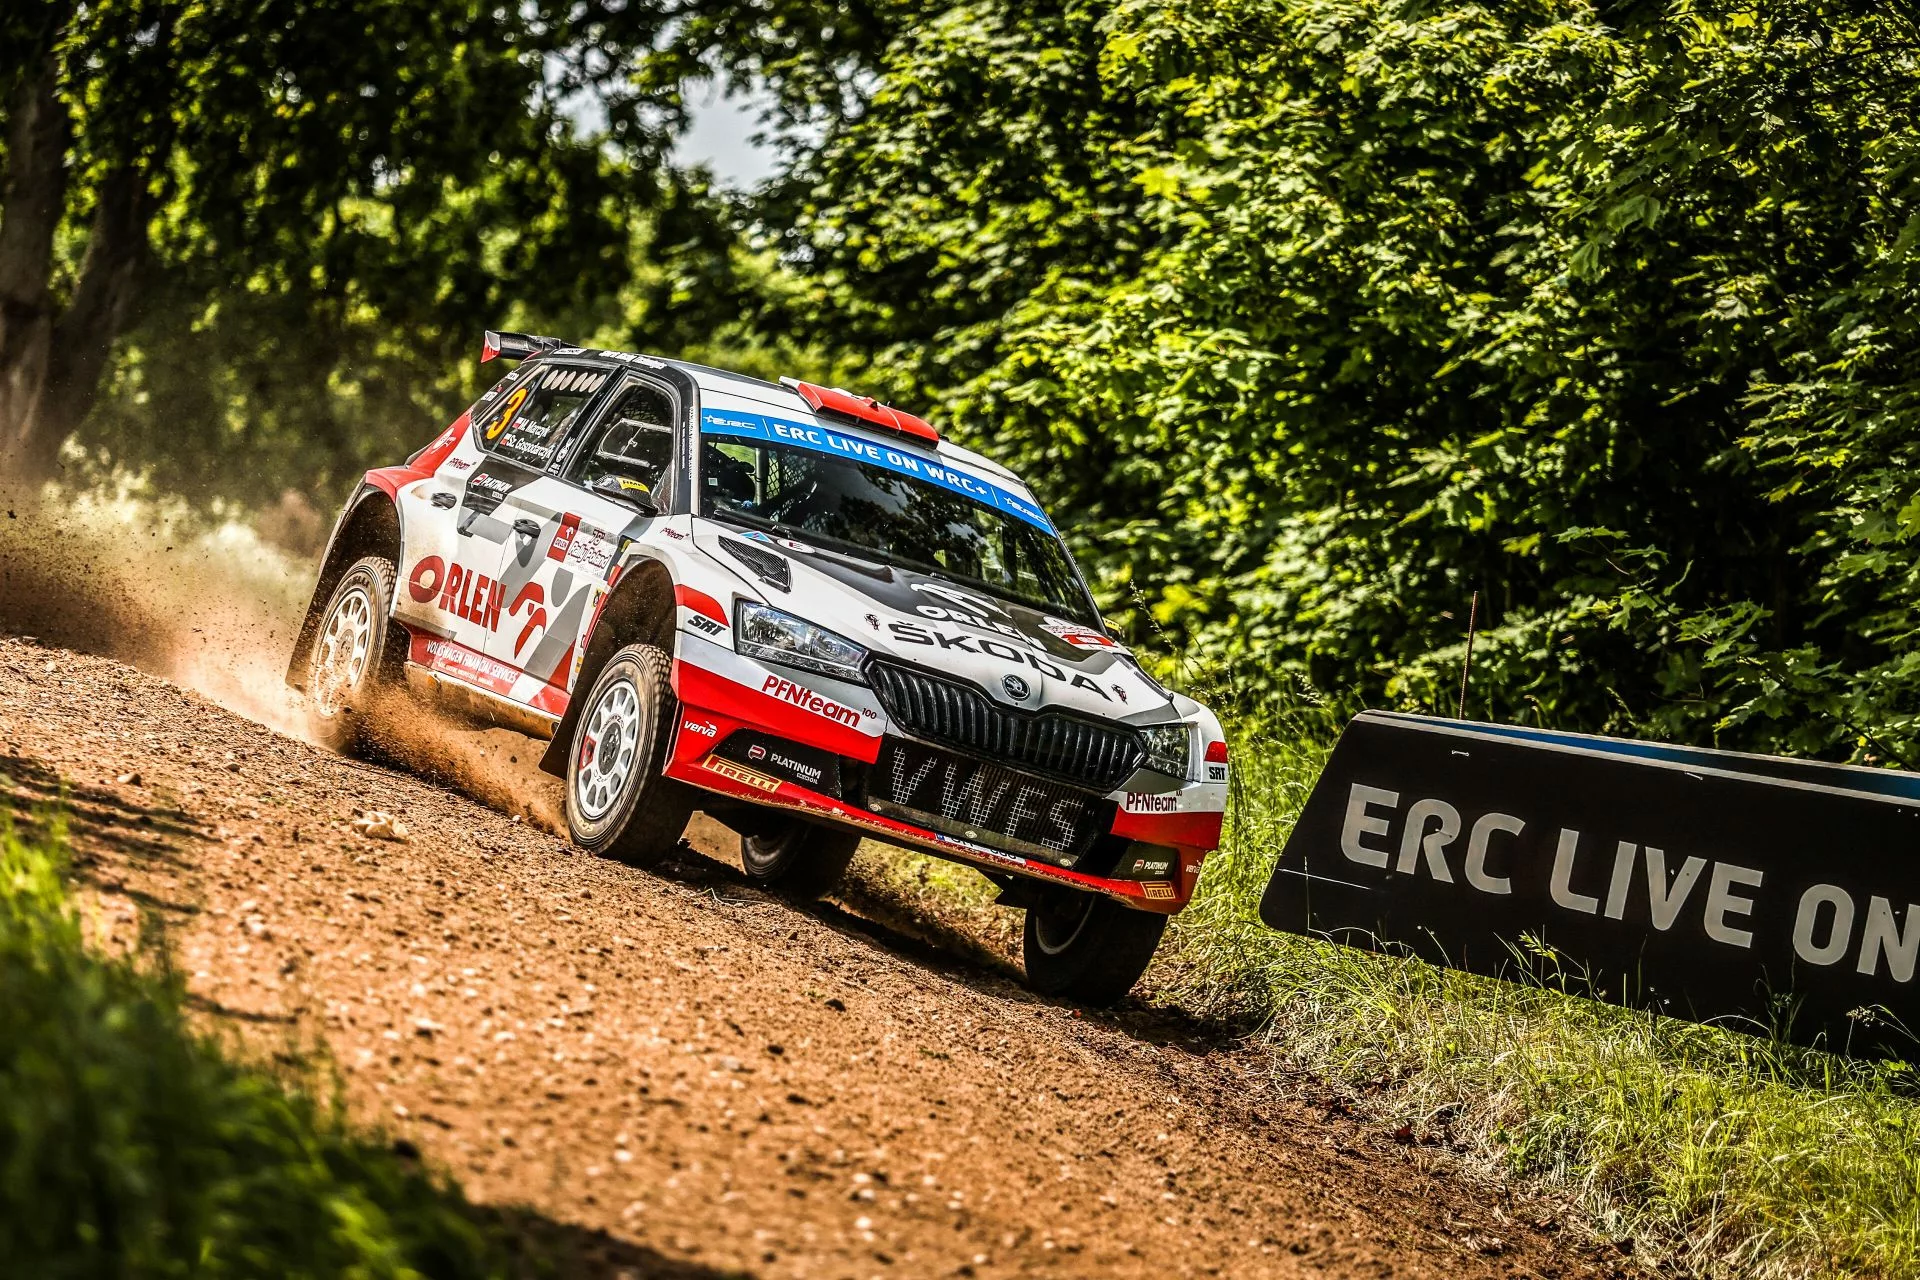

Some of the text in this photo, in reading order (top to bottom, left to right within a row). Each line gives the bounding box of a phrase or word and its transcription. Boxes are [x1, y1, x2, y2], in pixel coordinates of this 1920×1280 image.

[487, 388, 527, 440] 3
[773, 423, 988, 496] ERC LIVE ON WRC+
[408, 555, 507, 633] ORLEN
[687, 614, 727, 637] SRT
[916, 605, 1048, 651] ORLEN
[427, 640, 465, 664] VOLKSWAGEN
[462, 653, 492, 674] FINANCIAL
[491, 664, 519, 684] SERVICES
[888, 620, 1113, 703] ŠKODA
[761, 675, 877, 728] PFNteam 100
[684, 720, 717, 738] verva
[705, 755, 780, 792] PIRELLI
[771, 753, 821, 779] PLATINUM
[1208, 766, 1226, 780] SRT
[892, 746, 1084, 851] VWFS
[1126, 792, 1177, 812] PFNteam
[1142, 882, 1174, 898] PIRELLI
[1341, 782, 1920, 983] ERC LIVE ON
